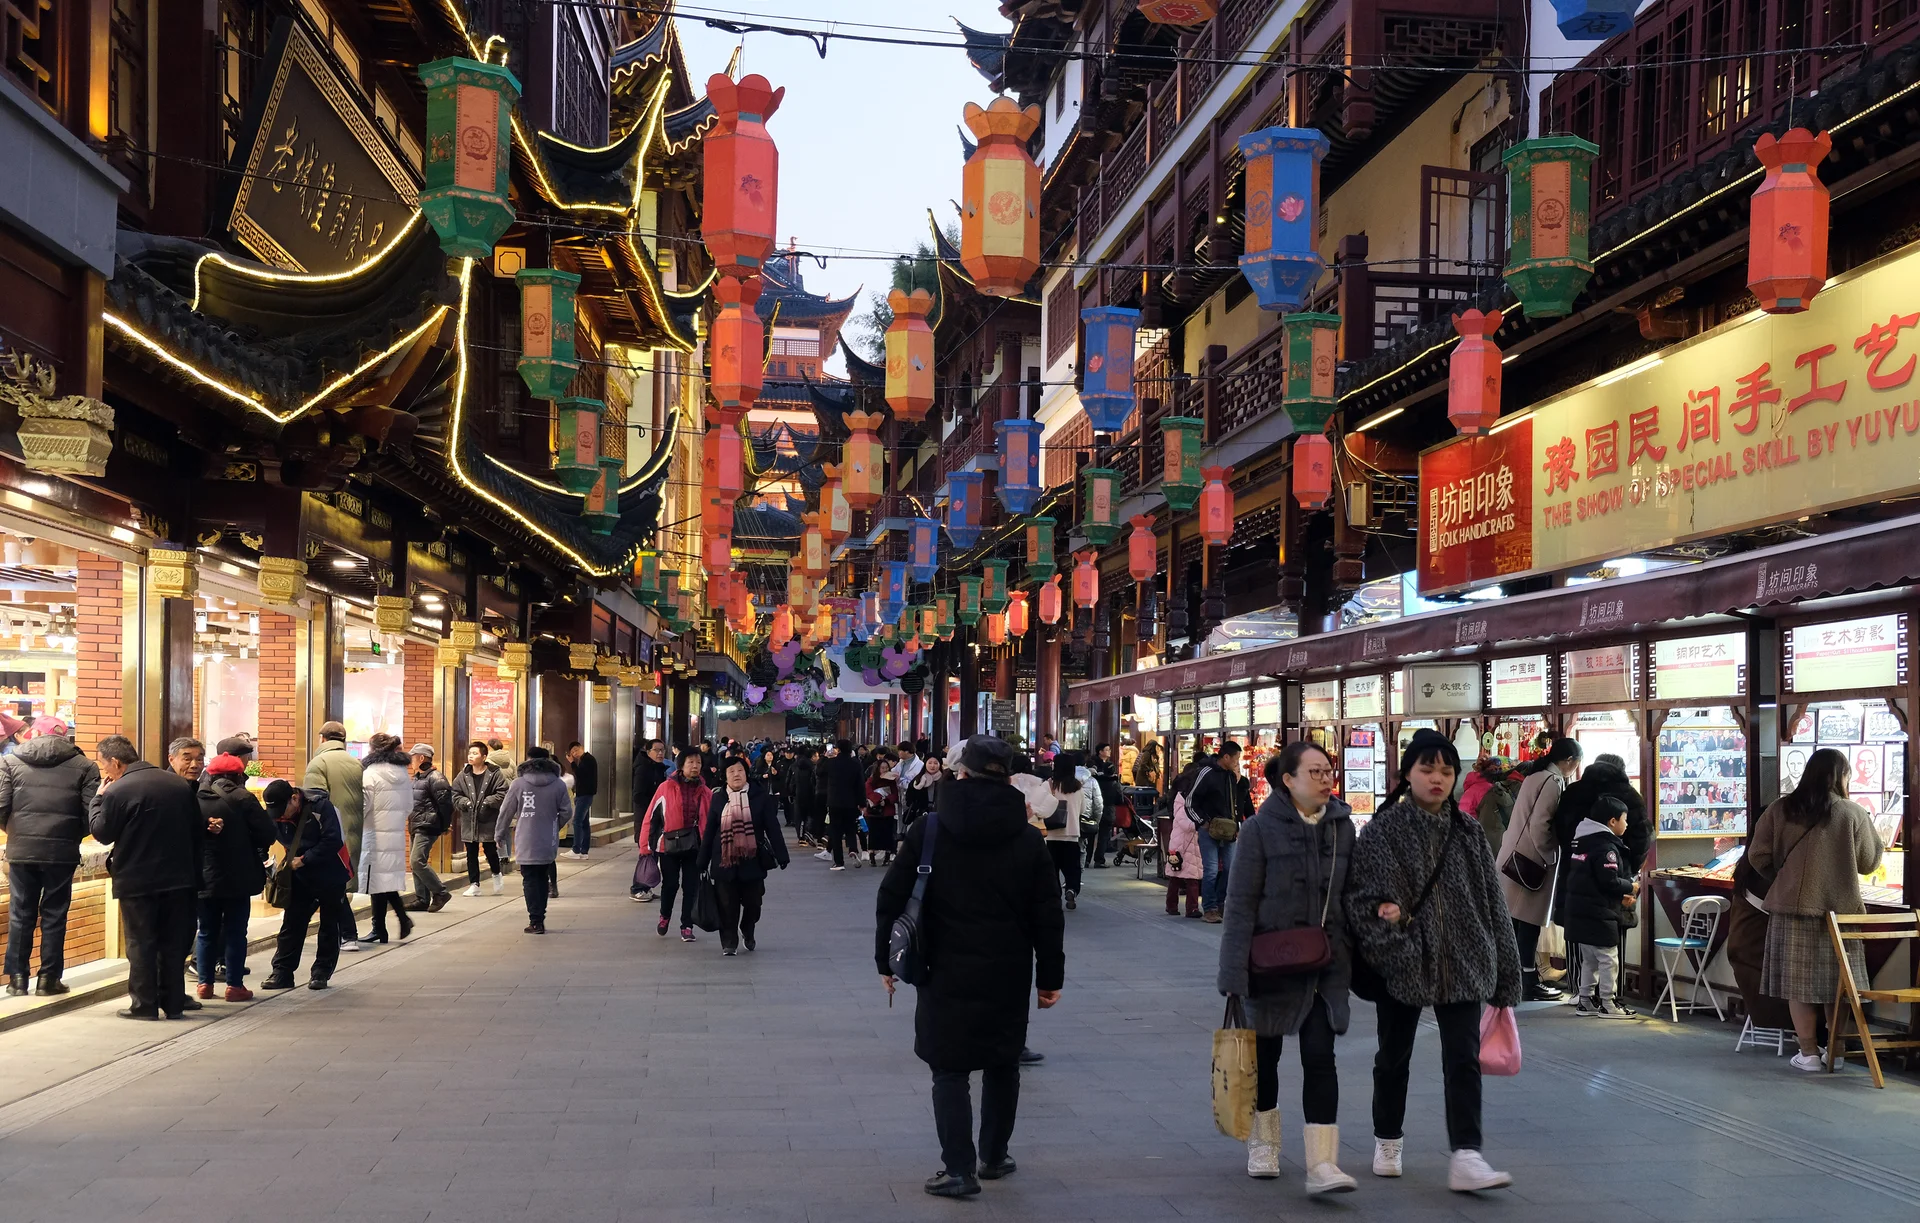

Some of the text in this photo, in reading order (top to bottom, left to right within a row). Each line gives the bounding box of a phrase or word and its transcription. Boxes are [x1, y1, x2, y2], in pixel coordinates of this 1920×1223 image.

[1543, 312, 1920, 496] 豫园民间手工艺
[1543, 400, 1920, 529] THE SHOW OF SPECIAL SKILL BY YUYU
[1440, 464, 1515, 526] 坊间印象
[1440, 513, 1515, 549] FOLK HANDICRAFTS
[1769, 563, 1818, 588] 坊间印象
[1765, 581, 1819, 596] FOLK HANDICRAFTS
[1590, 599, 1624, 619] 坊间印象
[1822, 624, 1884, 646] 艺术剪影
[1676, 643, 1727, 660] 铜印艺术
[1440, 682, 1472, 691] 收银台
